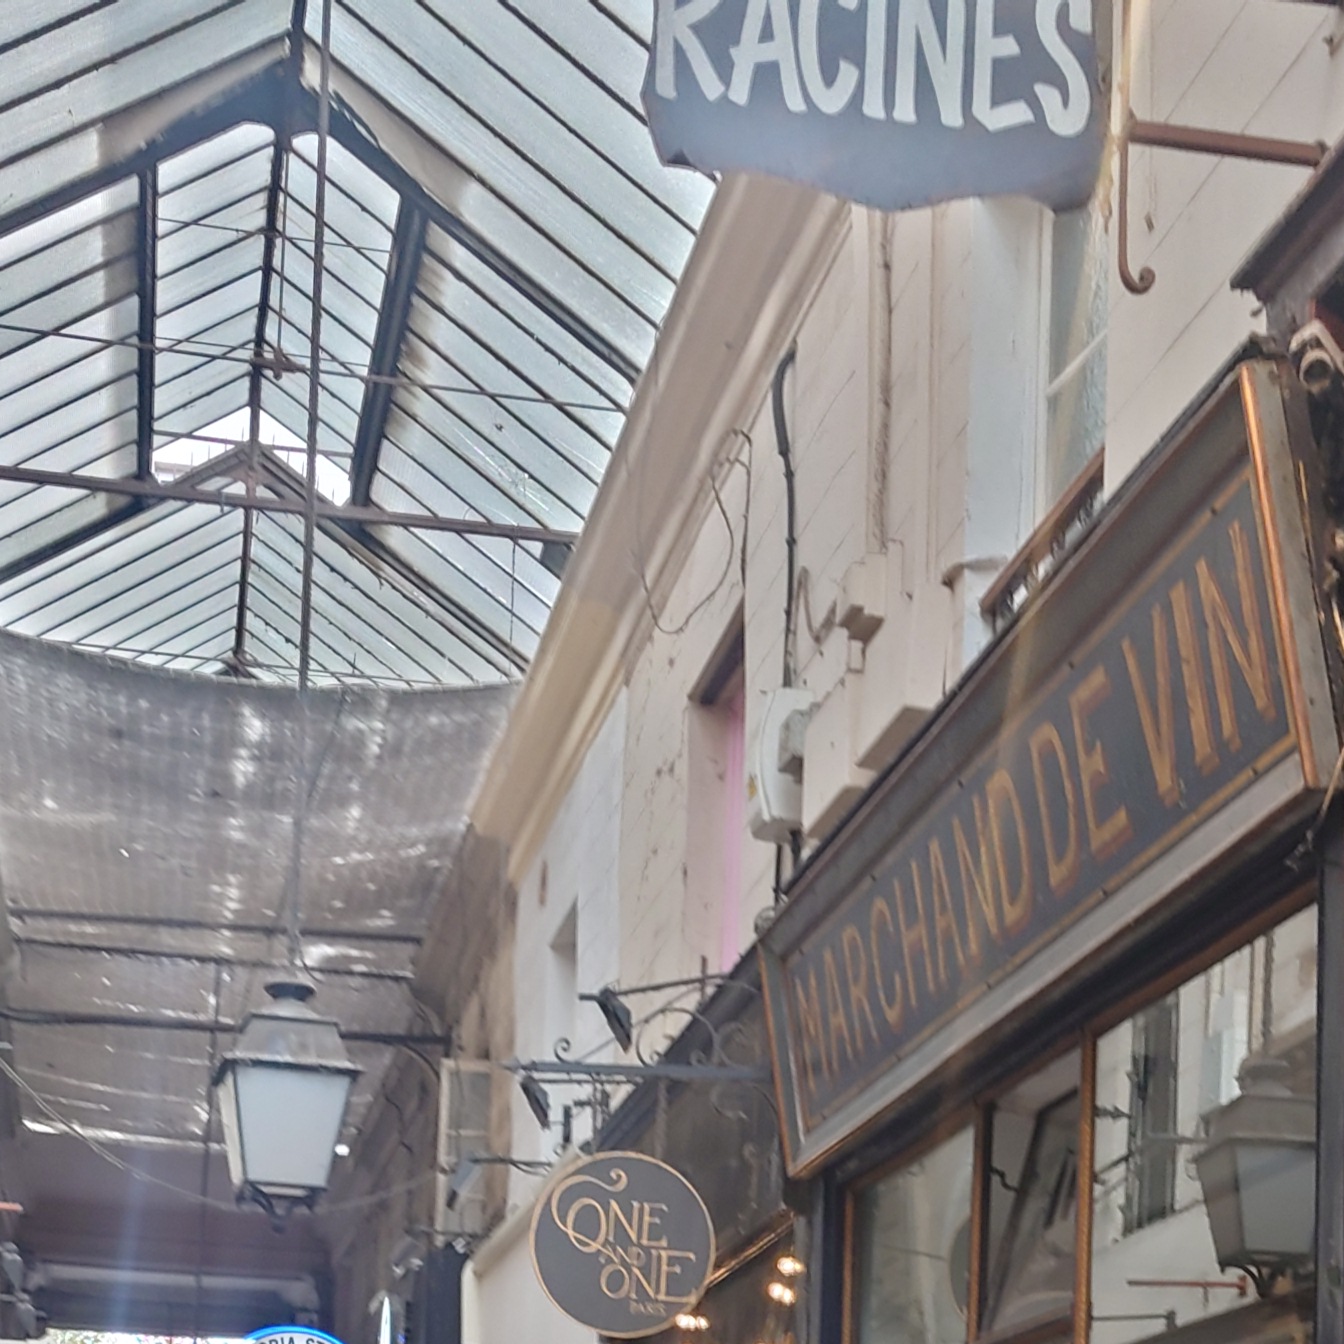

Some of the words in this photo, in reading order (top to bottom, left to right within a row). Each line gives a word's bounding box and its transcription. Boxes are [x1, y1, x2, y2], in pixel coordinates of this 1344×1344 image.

[654, 0, 1093, 137] RACINES
[794, 769, 1034, 1099] MARCHAND
[1030, 664, 1135, 860] DE
[1122, 519, 1277, 807] VIN
[564, 1194, 669, 1253] ONE
[599, 1249, 697, 1303] ONE
